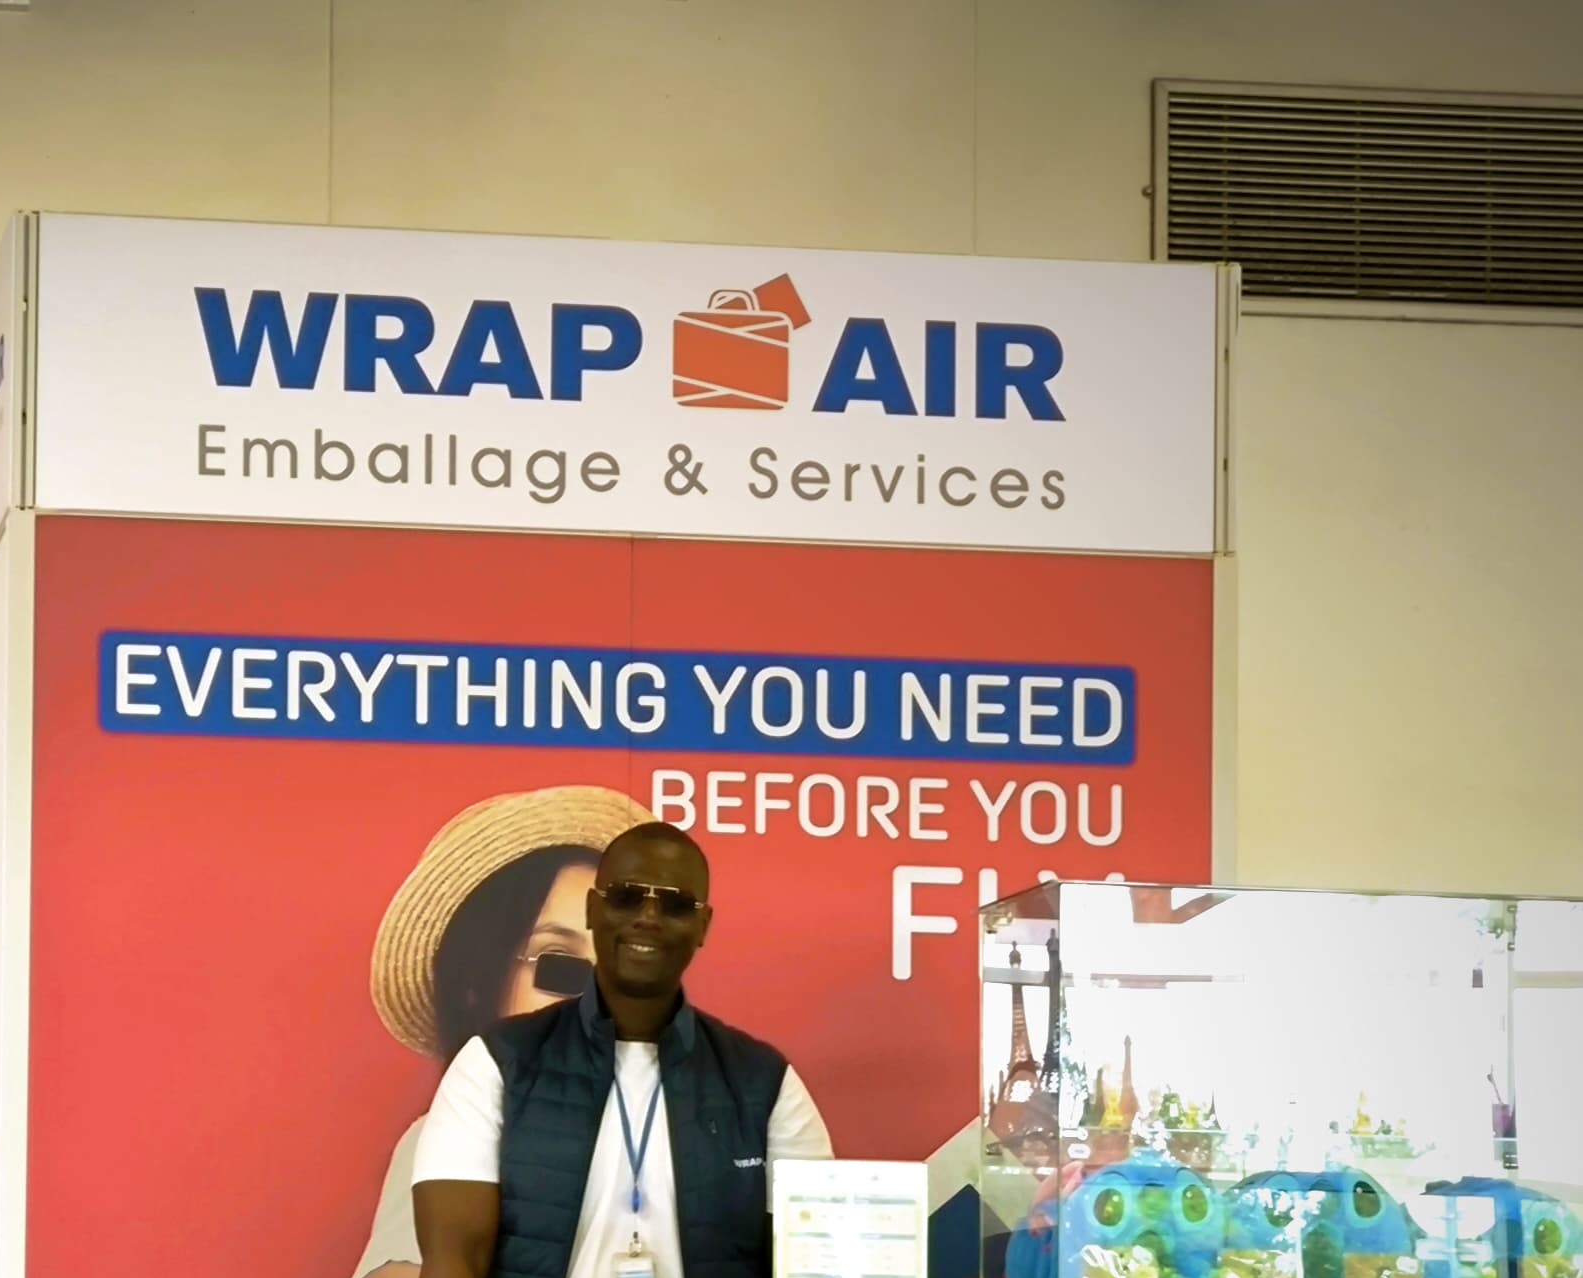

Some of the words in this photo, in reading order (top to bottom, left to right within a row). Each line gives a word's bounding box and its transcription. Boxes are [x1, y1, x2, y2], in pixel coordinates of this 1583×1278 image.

[192, 288, 642, 402] WRAP
[812, 317, 1067, 422] AIR
[197, 425, 621, 503] Emballage
[664, 446, 708, 494] &
[748, 450, 1067, 509] Services
[114, 645, 666, 733] EVERYTHING
[693, 666, 867, 740] YOU
[900, 671, 1123, 748] NEED
[651, 770, 949, 841] BEFORE
[970, 780, 1123, 846] YOU
